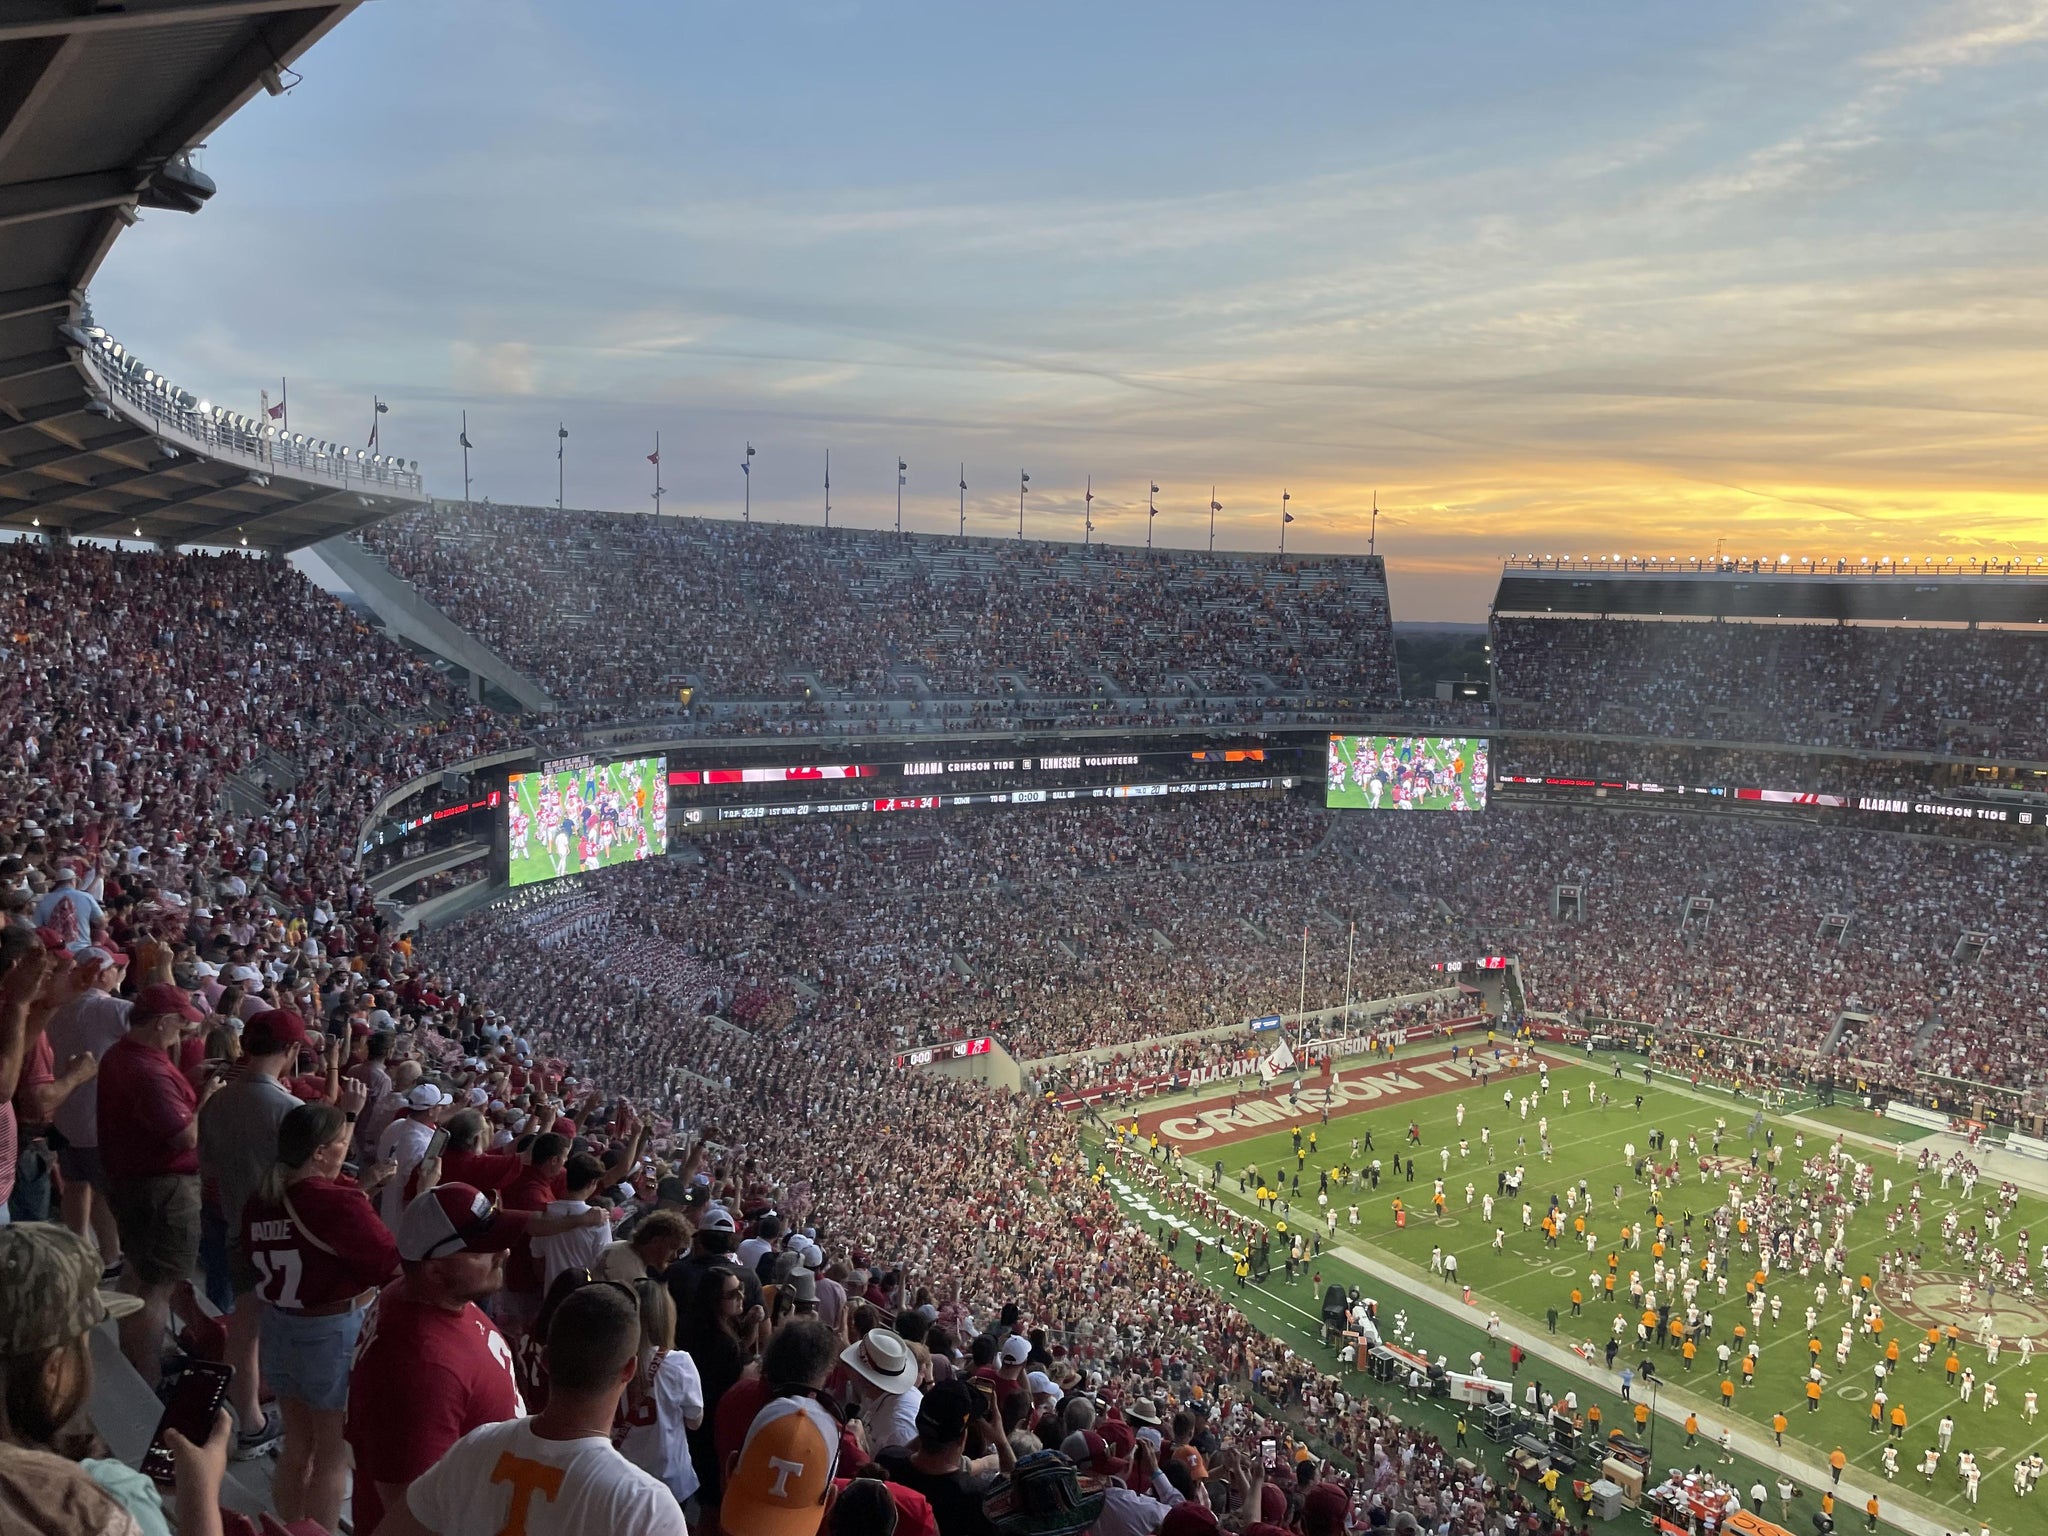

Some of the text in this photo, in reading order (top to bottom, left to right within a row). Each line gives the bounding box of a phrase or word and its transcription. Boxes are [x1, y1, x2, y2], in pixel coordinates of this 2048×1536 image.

[904, 762, 943, 775] ALABAMA
[948, 762, 990, 772] CRIMSON
[993, 761, 1014, 770] TIDE
[1040, 757, 1080, 770] TENNESSEE
[1085, 756, 1138, 766] VOLUNTEERS
[1018, 792, 1039, 801] 0:00
[1052, 791, 1066, 799] BALL
[1105, 787, 1112, 797] 4
[1218, 782, 1227, 791] 22
[741, 807, 764, 818] 32:19
[797, 805, 809, 815] 20
[861, 802, 868, 811] 5
[920, 797, 933, 808] 34
[1859, 797, 1908, 813] ALABAMA
[1915, 804, 1972, 818] CRIMSON
[1977, 809, 2007, 821] TIDE
[1447, 962, 1461, 971] 0:00
[1477, 959, 1486, 968] 40
[911, 1052, 930, 1065] 0:00
[955, 1044, 967, 1055] 40
[1310, 1036, 1371, 1061] CRISON
[1160, 1047, 1536, 1141] CRIMSON TIDE
[1523, 1256, 1576, 1278] 30
[251, 1249, 304, 1309] 17
[1186, 1454, 1197, 1467] T
[768, 1456, 804, 1497] T
[490, 1453, 567, 1536] T
